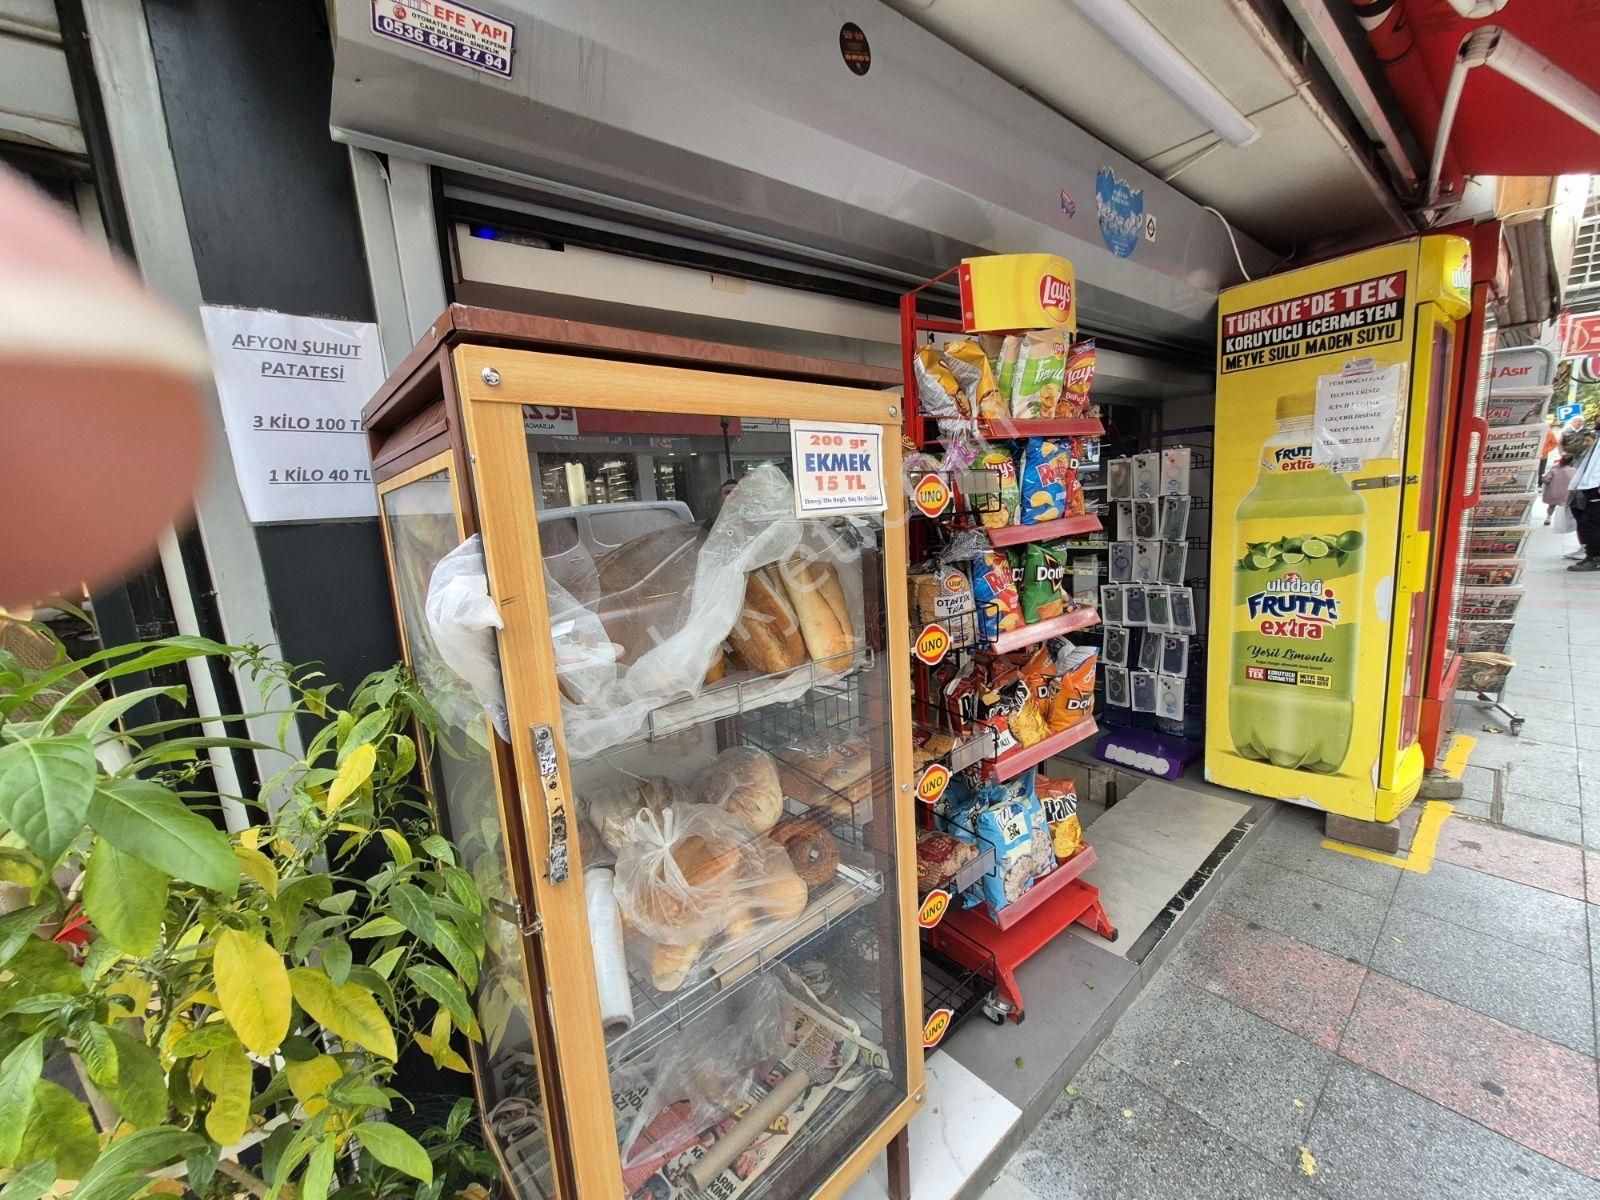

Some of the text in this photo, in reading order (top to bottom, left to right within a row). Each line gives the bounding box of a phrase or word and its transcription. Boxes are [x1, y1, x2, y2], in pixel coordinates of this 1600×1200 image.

[419, 22, 435, 33] CAM
[434, 4, 507, 43] EFE YAPI
[383, 17, 503, 70] 0536 641 27 94
[1341, 276, 1398, 308] TEK
[232, 333, 297, 352] AFYON
[1225, 322, 1303, 353] KORUYUCU
[1225, 323, 1395, 370] MEYVE SULU MADEN SUYU
[261, 361, 345, 380] PATATESİ
[253, 415, 264, 428] 3
[270, 413, 310, 430] KİLO
[315, 418, 346, 431] 100
[1560, 407, 1573, 419] P
[810, 434, 868, 449] 200 gr
[805, 453, 872, 472] EKMEK
[1282, 459, 1315, 471] extra
[269, 469, 278, 481] 1
[285, 467, 324, 482] KİLO
[329, 469, 349, 482] 40
[815, 475, 866, 491] 15 TL
[920, 490, 943, 503] UNO
[1260, 618, 1322, 639] extra
[921, 637, 943, 653] UNO
[1282, 648, 1335, 663] Limonlu
[922, 774, 943, 794] UNO
[922, 900, 943, 920] UNO
[925, 1018, 945, 1038] UNO
